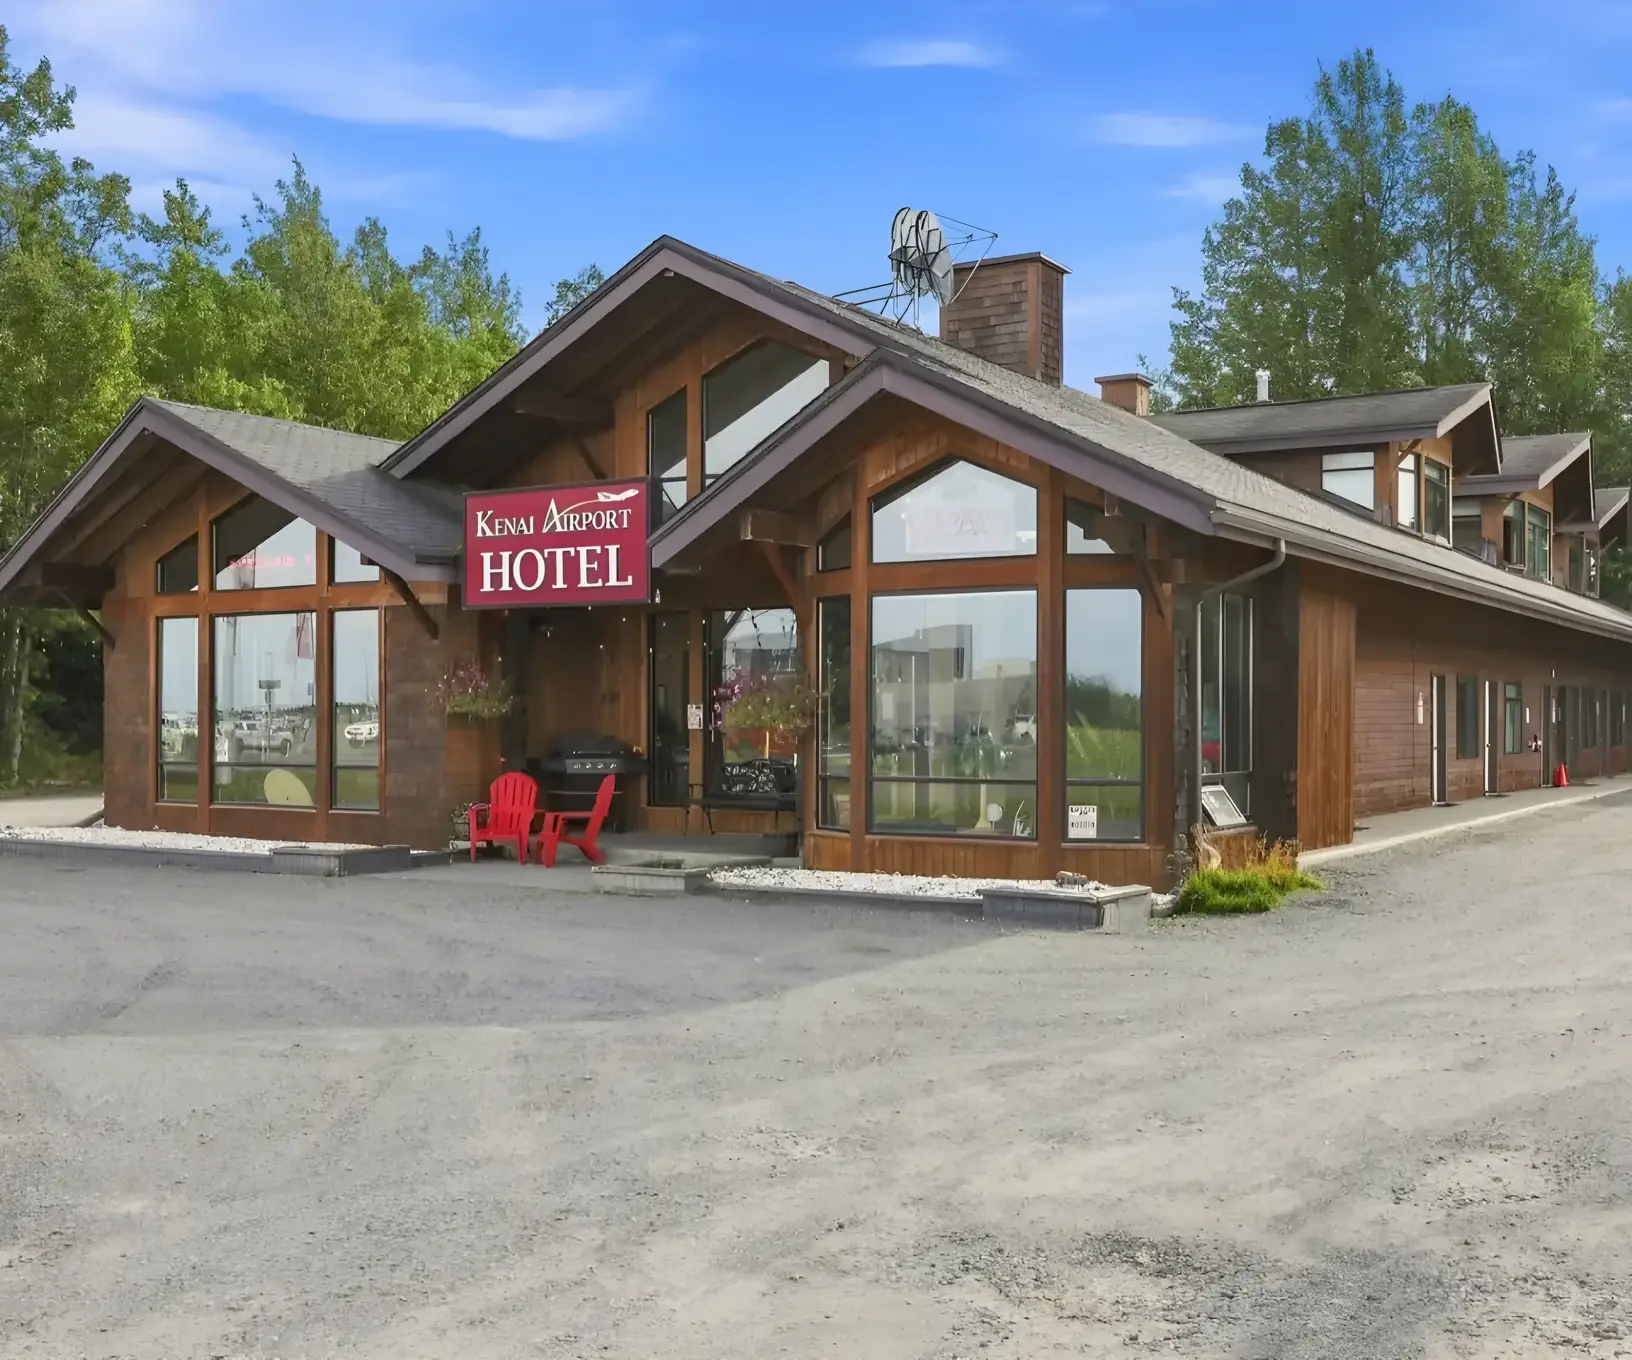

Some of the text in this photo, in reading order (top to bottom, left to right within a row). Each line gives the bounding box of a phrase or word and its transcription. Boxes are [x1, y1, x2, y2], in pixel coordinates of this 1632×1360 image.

[476, 497, 632, 537] KENAI AIRPORT
[480, 545, 633, 592] HOTEL
